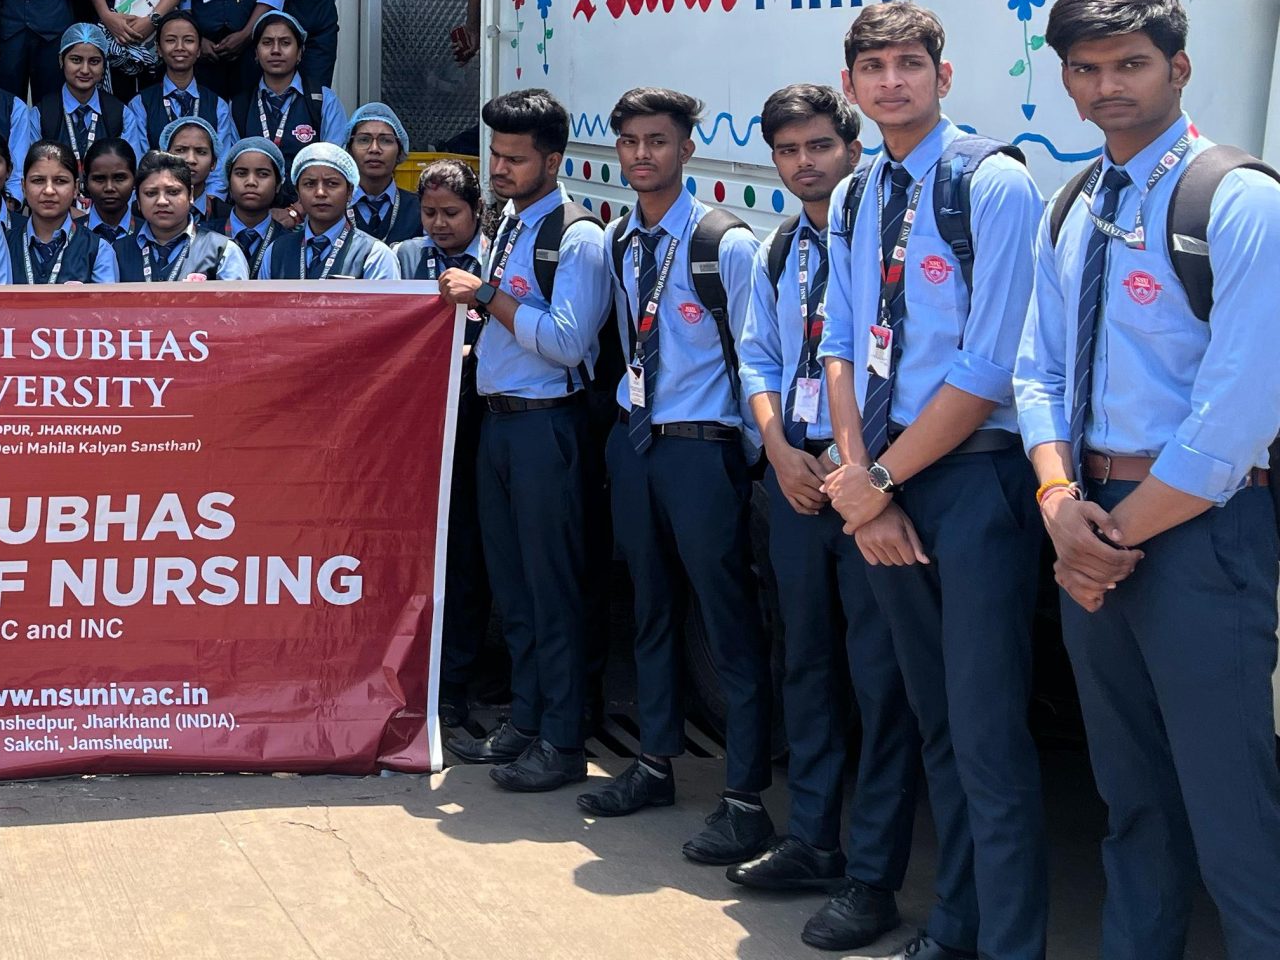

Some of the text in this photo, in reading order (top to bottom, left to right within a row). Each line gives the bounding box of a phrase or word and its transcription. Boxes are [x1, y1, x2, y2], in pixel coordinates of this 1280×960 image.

[1172, 133, 1194, 155] NSU
[1147, 165, 1166, 188] NSU
[911, 188, 921, 204] NSU
[900, 225, 911, 241] NSU
[499, 251, 508, 268] NSU
[30, 329, 210, 363] SUBHAS
[37, 423, 122, 436] JHARKHAND
[27, 441, 75, 454] Mahila
[79, 441, 127, 456] Kalyan
[131, 438, 202, 454] Sansthan)
[49, 554, 363, 609] NURSING
[26, 619, 71, 640] and
[81, 617, 124, 639] INC
[82, 712, 171, 730] Jharkhand
[175, 712, 241, 732] (INDIA).
[3, 736, 65, 754] Sakchi,
[68, 734, 173, 754] Jamshedpur.
